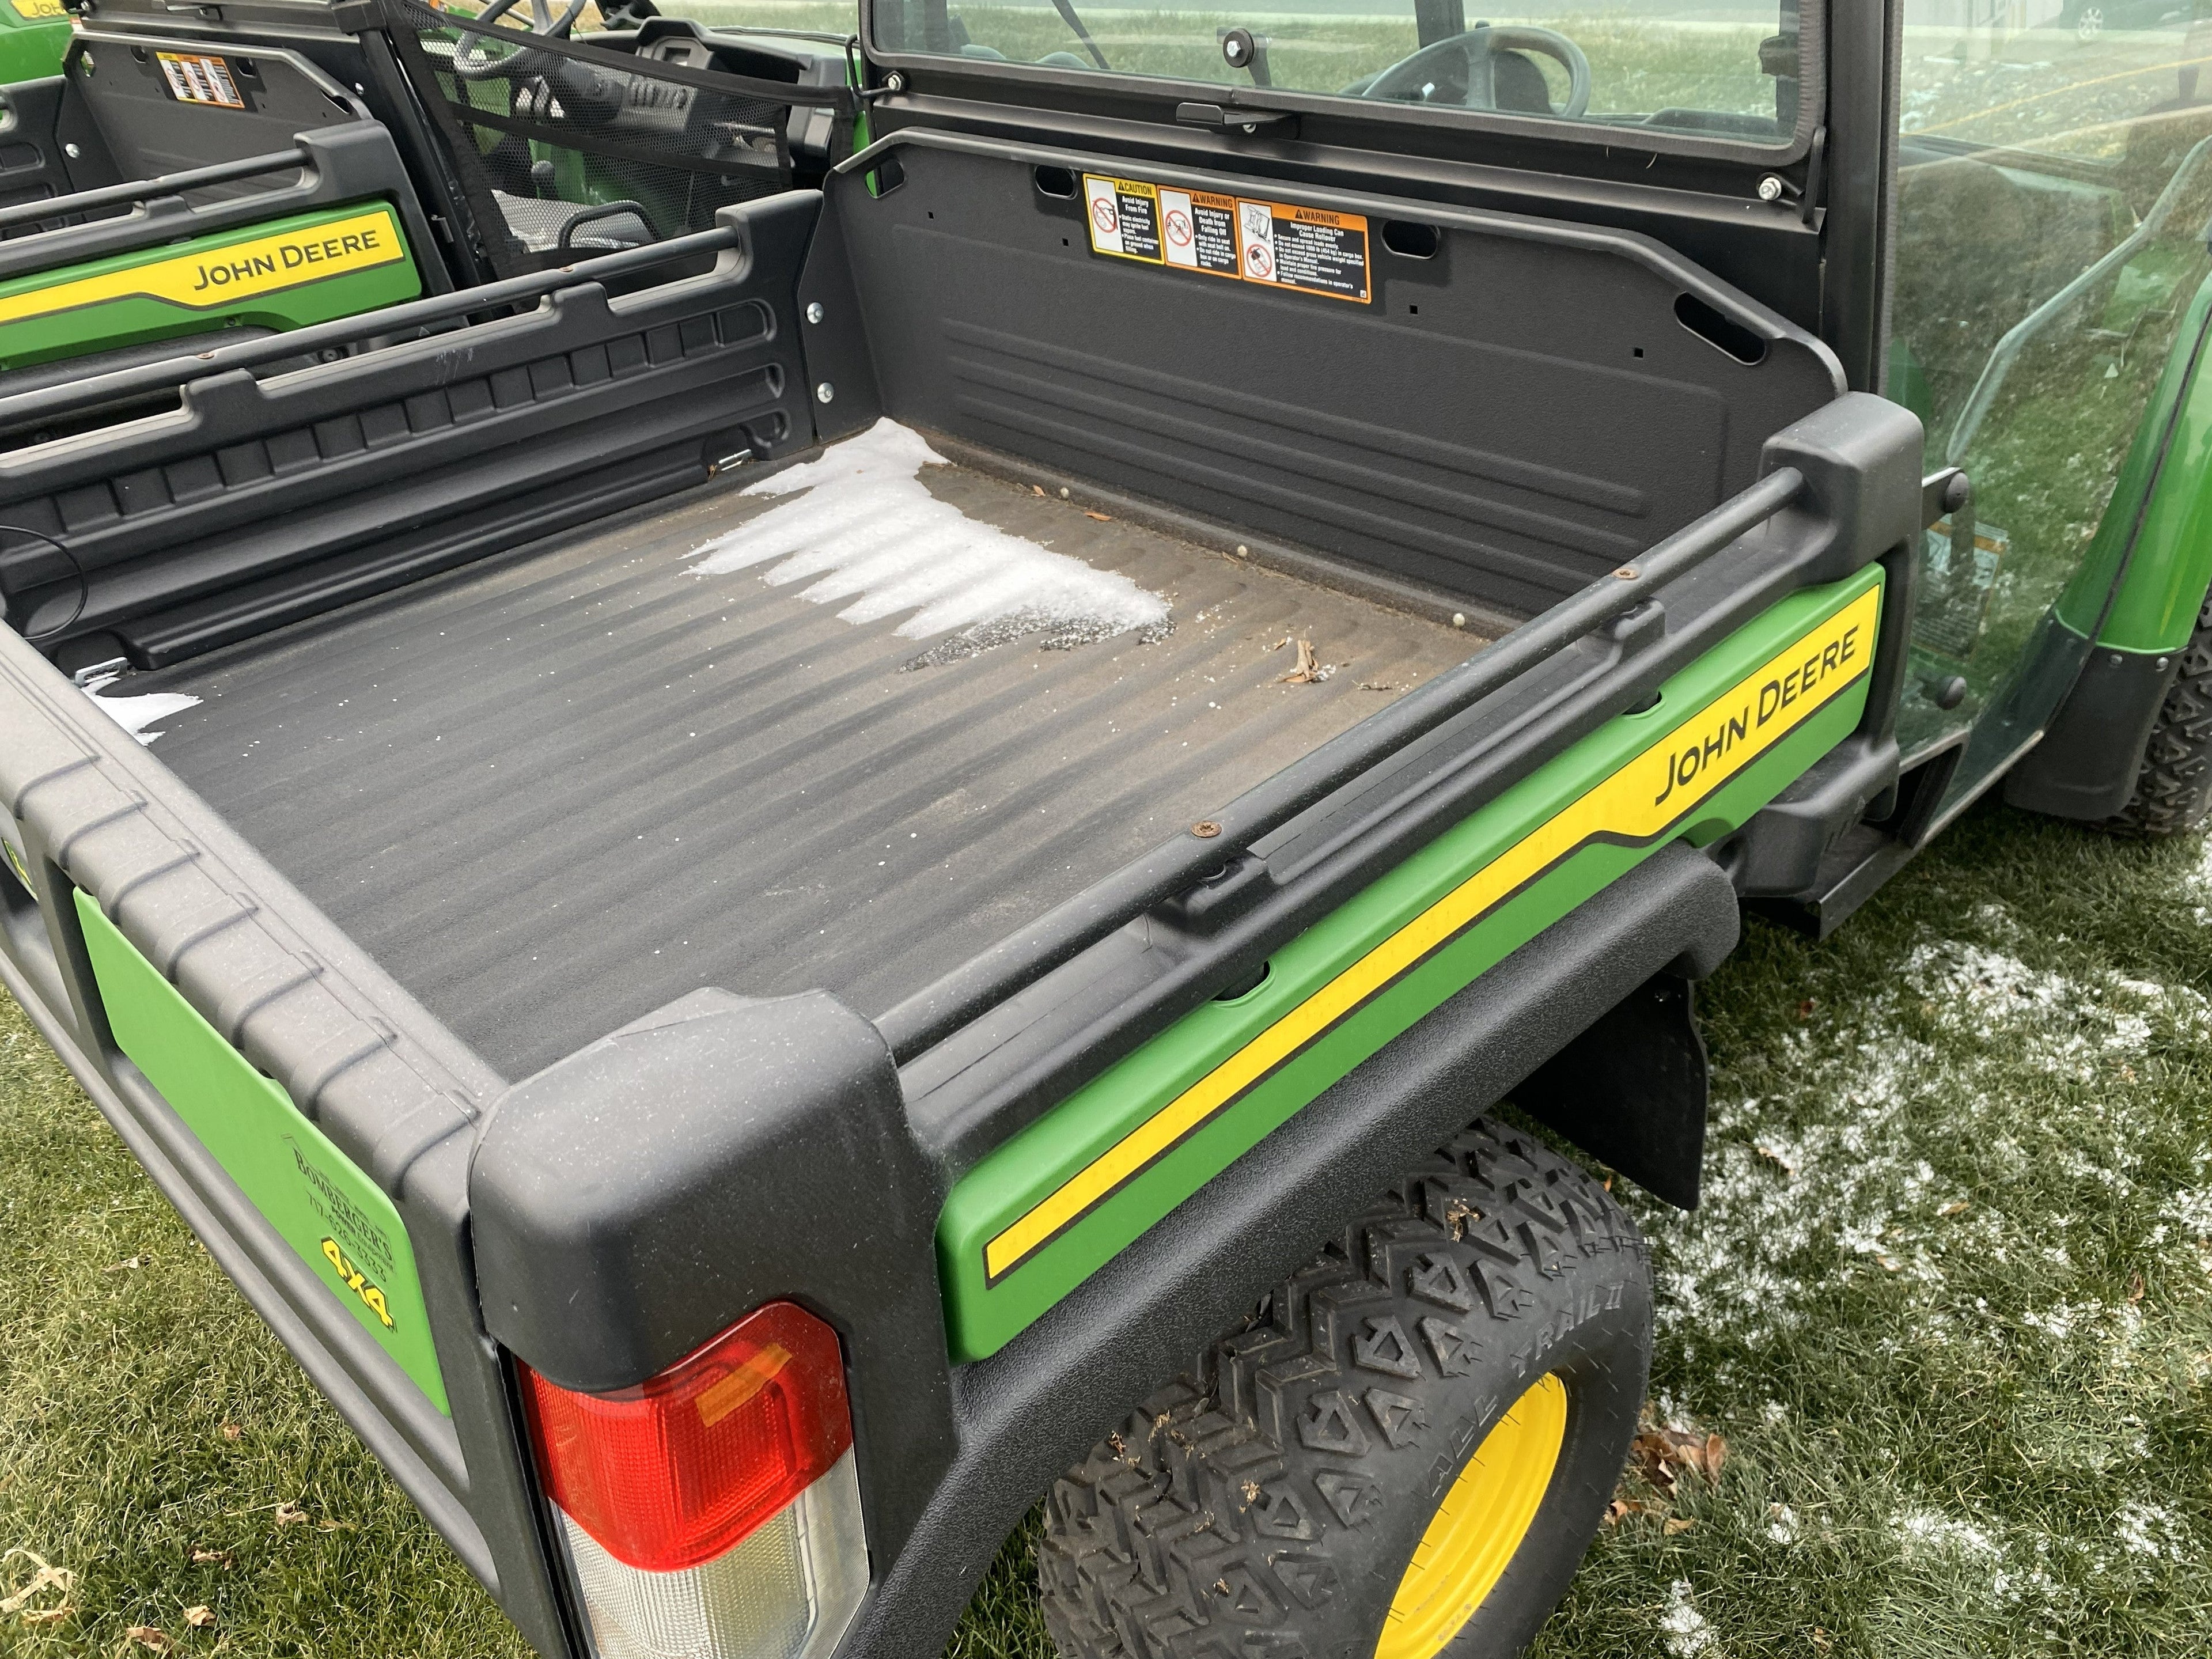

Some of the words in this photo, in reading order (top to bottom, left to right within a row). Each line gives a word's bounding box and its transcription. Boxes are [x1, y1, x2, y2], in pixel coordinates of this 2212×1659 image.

[32, 2, 65, 15] JOH
[1125, 183, 1152, 195] CAUTION
[1122, 196, 1134, 204] Avoid
[1135, 198, 1149, 207] Injury
[1199, 194, 1233, 208] WARNING
[1126, 204, 1137, 212] From
[1195, 207, 1209, 216] Avoid
[1209, 210, 1224, 220] Injury
[1199, 216, 1213, 225] Death
[1214, 219, 1226, 227] from
[1302, 210, 1340, 225] WARNING
[1201, 225, 1218, 236] Falling
[1290, 222, 1312, 232] Improper
[1313, 225, 1333, 236] Loading
[1299, 230, 1314, 238] Cause
[1315, 233, 1336, 242] Rollover
[194, 254, 276, 291] JOHN
[279, 229, 380, 269] DEERE
[1654, 705, 1749, 806] JOHN
[1756, 623, 1860, 730] DEERE
[293, 1147, 392, 1262] BOMBERGER'S
[305, 1188, 387, 1282] 717-626-3333
[1428, 1395, 1497, 1497] ALL
[1509, 1289, 1601, 1378] TRAIL
